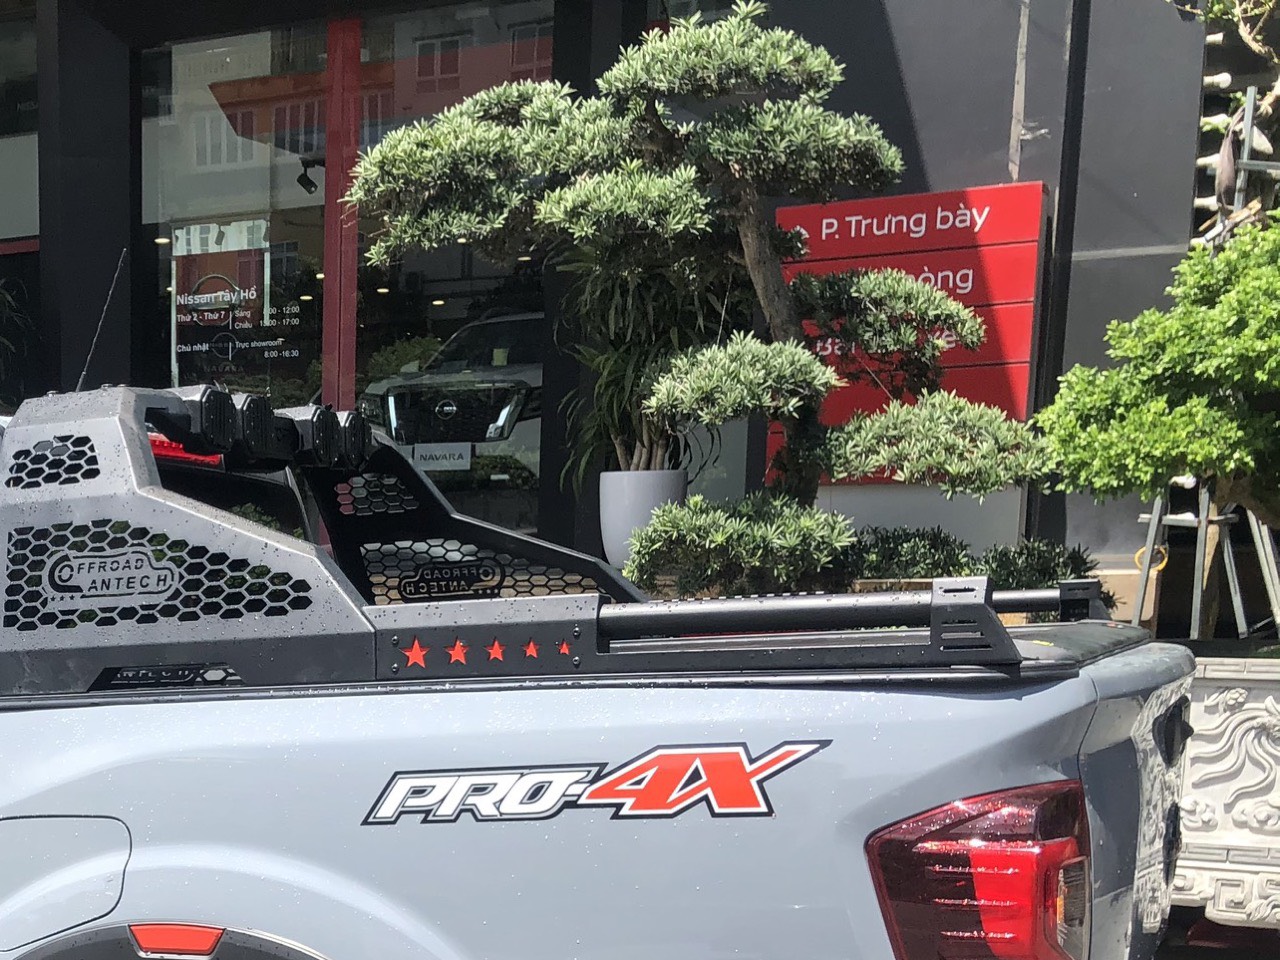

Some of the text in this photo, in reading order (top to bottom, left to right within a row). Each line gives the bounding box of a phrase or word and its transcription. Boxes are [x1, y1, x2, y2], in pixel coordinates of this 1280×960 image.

[821, 202, 990, 240] P. Trưng bày
[176, 285, 257, 305] Nissan Tây Hồ
[282, 306, 300, 314] 12:00
[220, 311, 226, 319] 7
[282, 318, 300, 326] 17:00
[250, 339, 282, 347] showroom
[263, 350, 278, 358] 8:00
[420, 453, 464, 461] NAVARA
[58, 558, 145, 583] OFFROAD
[360, 739, 833, 826] PRO-4X
